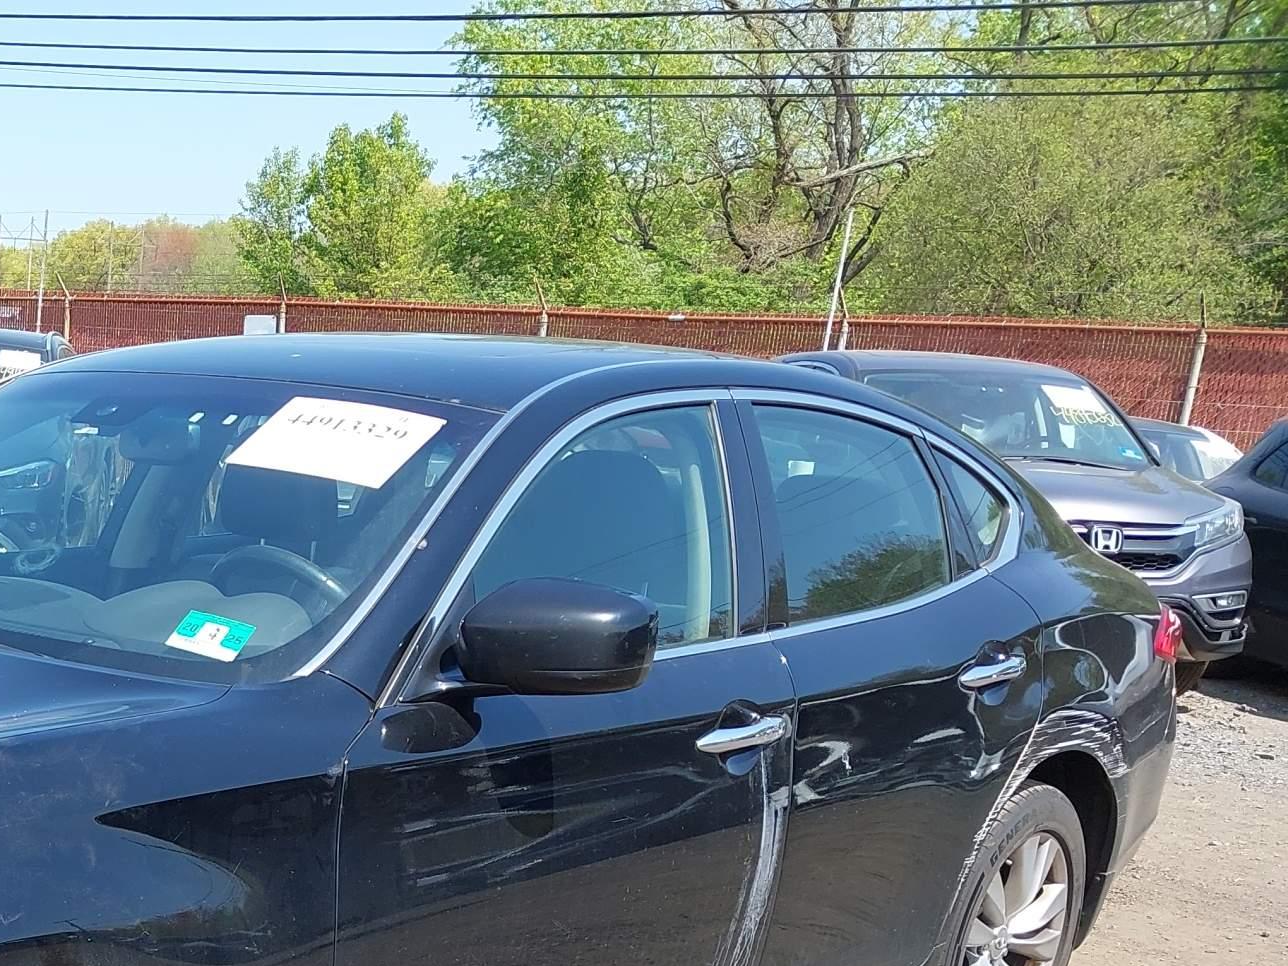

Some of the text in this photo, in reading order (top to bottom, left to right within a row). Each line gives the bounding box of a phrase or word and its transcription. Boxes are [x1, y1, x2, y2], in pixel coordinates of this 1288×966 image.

[287, 413, 408, 440] 44913329
[183, 622, 200, 632] 20
[225, 634, 244, 645] 25
